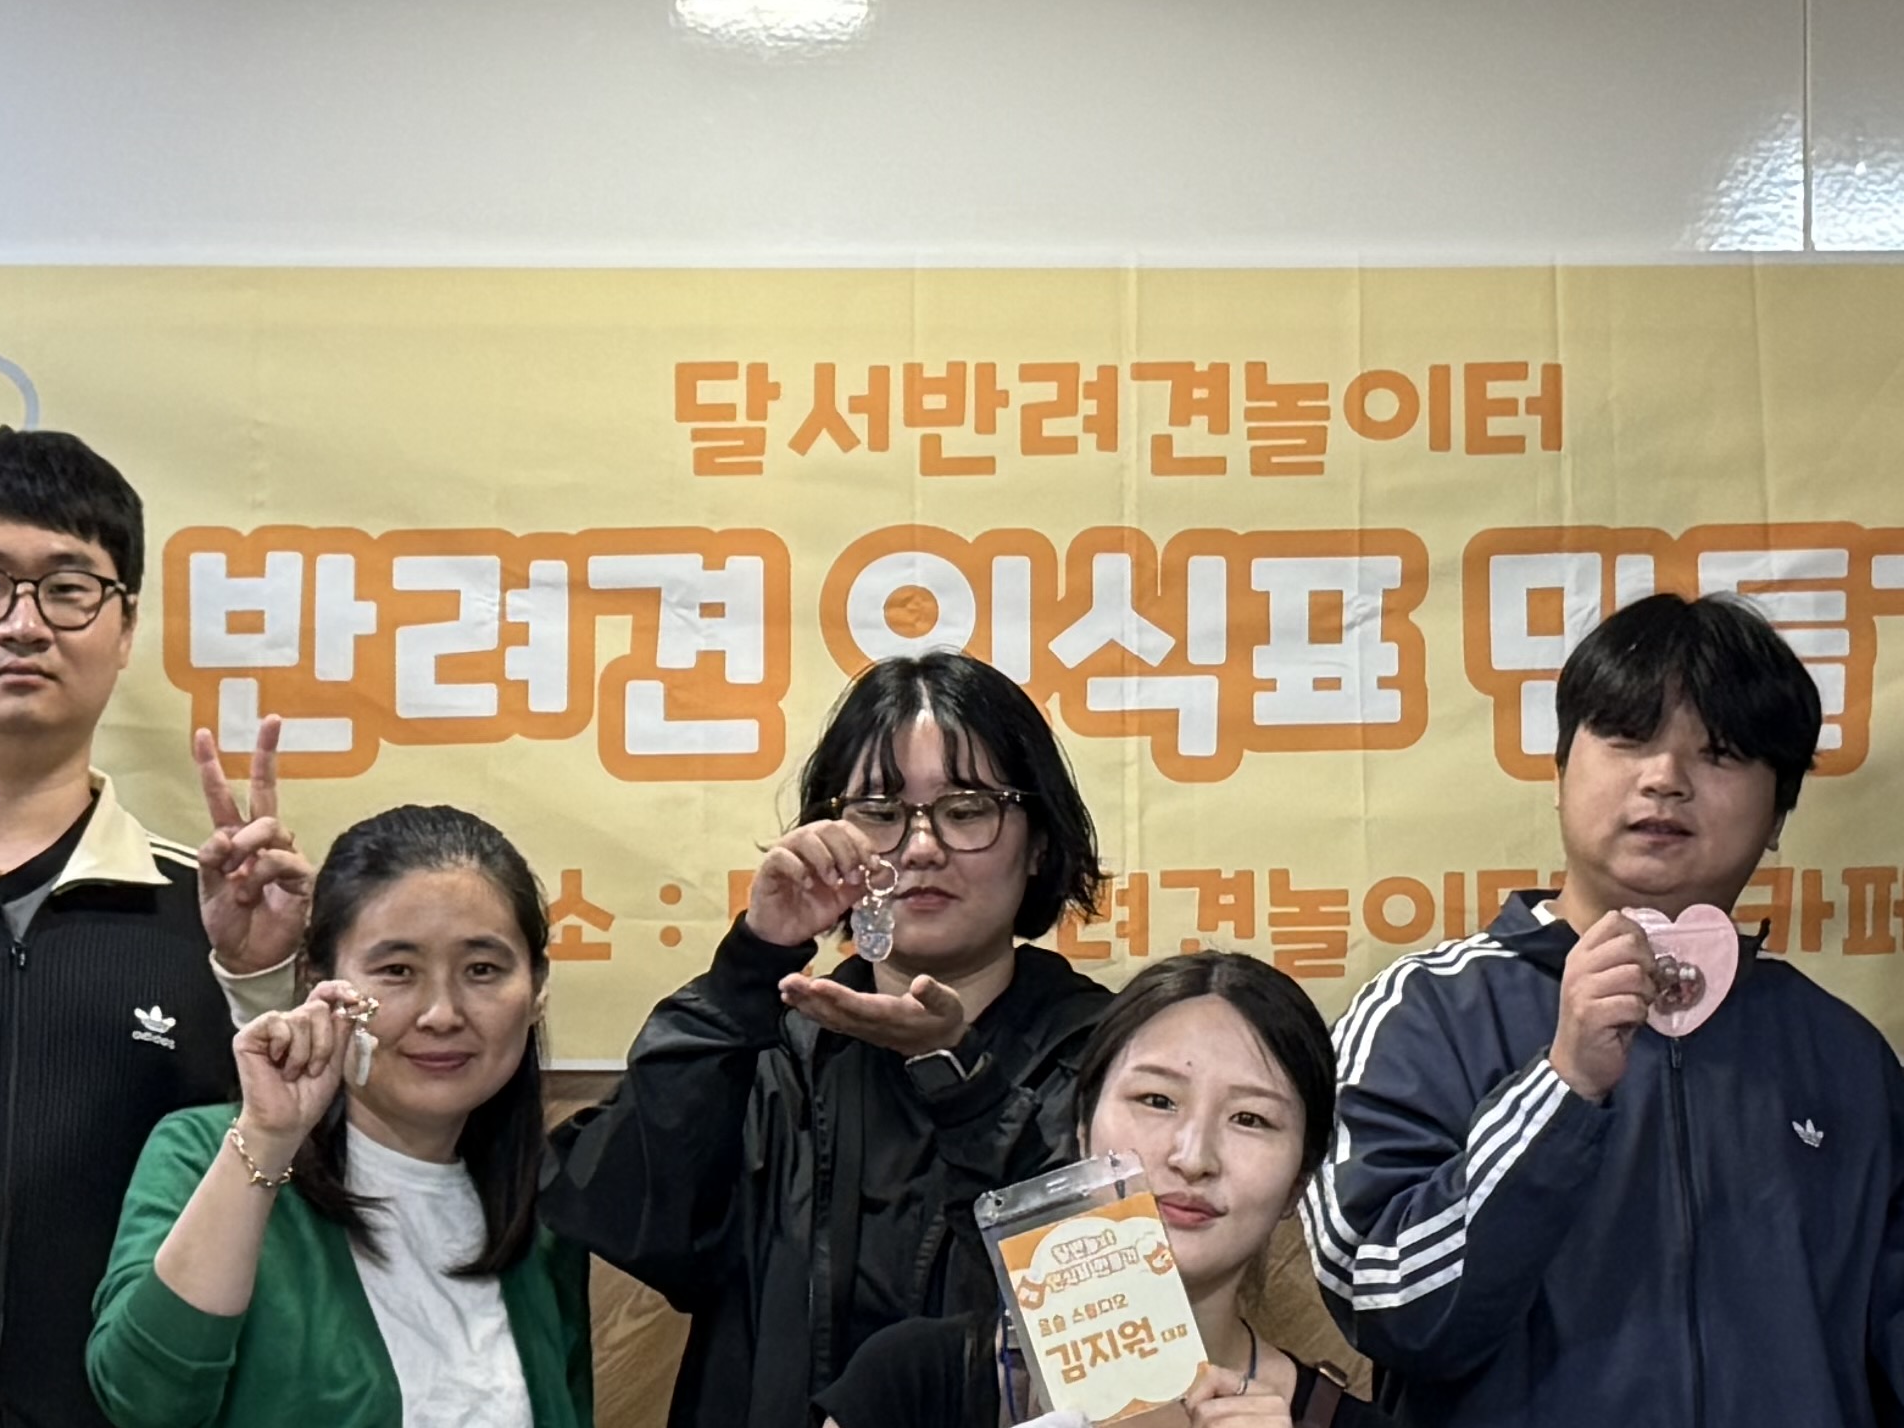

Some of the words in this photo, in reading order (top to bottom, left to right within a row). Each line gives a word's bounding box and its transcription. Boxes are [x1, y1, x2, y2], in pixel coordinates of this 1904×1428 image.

[674, 360, 1564, 477] 달서반려견놀이터
[189, 550, 764, 756] 반려견
[1045, 1315, 1159, 1385] 김지원
